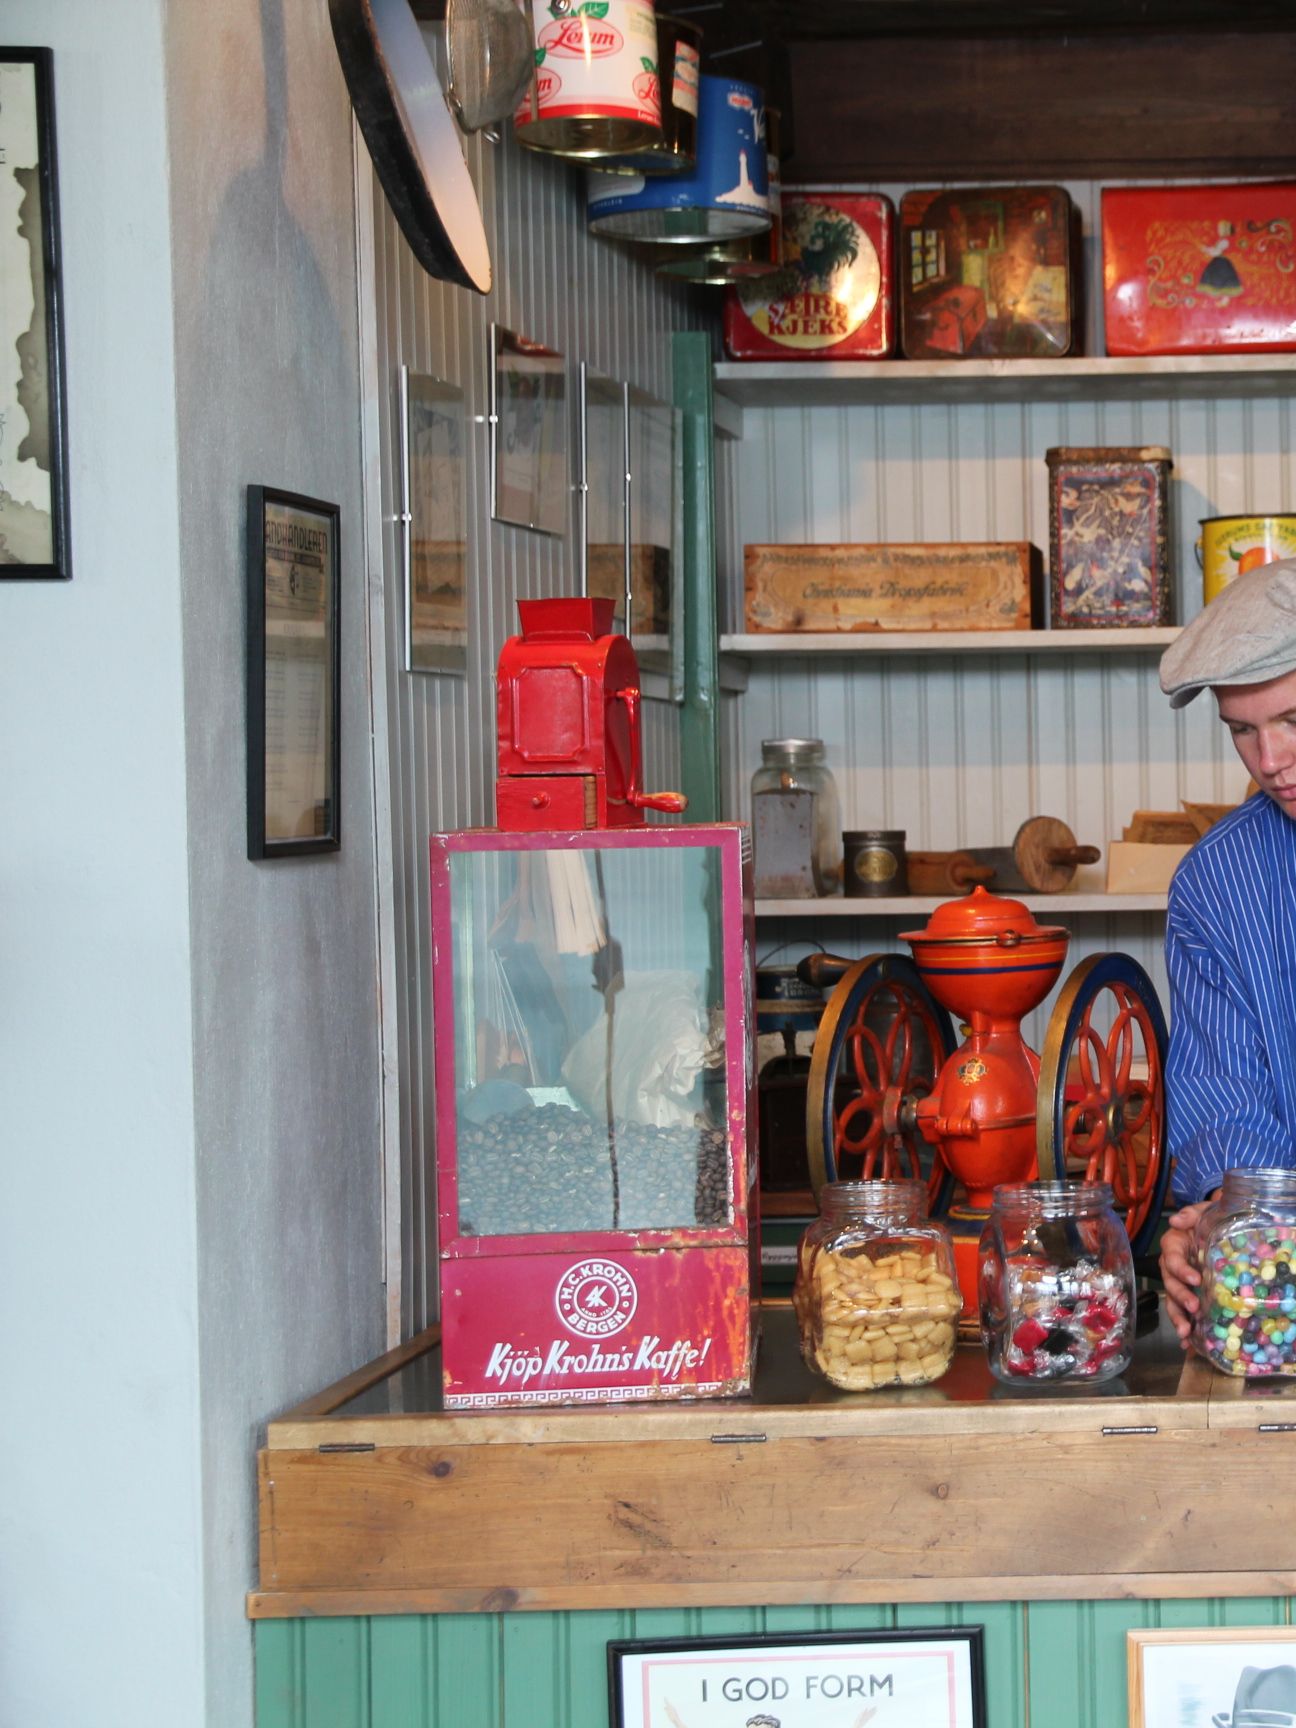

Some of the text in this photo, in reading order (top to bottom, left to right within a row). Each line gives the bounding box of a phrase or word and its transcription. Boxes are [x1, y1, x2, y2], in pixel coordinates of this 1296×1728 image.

[768, 316, 848, 336] KJEKS
[567, 1310, 627, 1335] BERGEN
[701, 1673, 894, 1702] I GOD FORM
